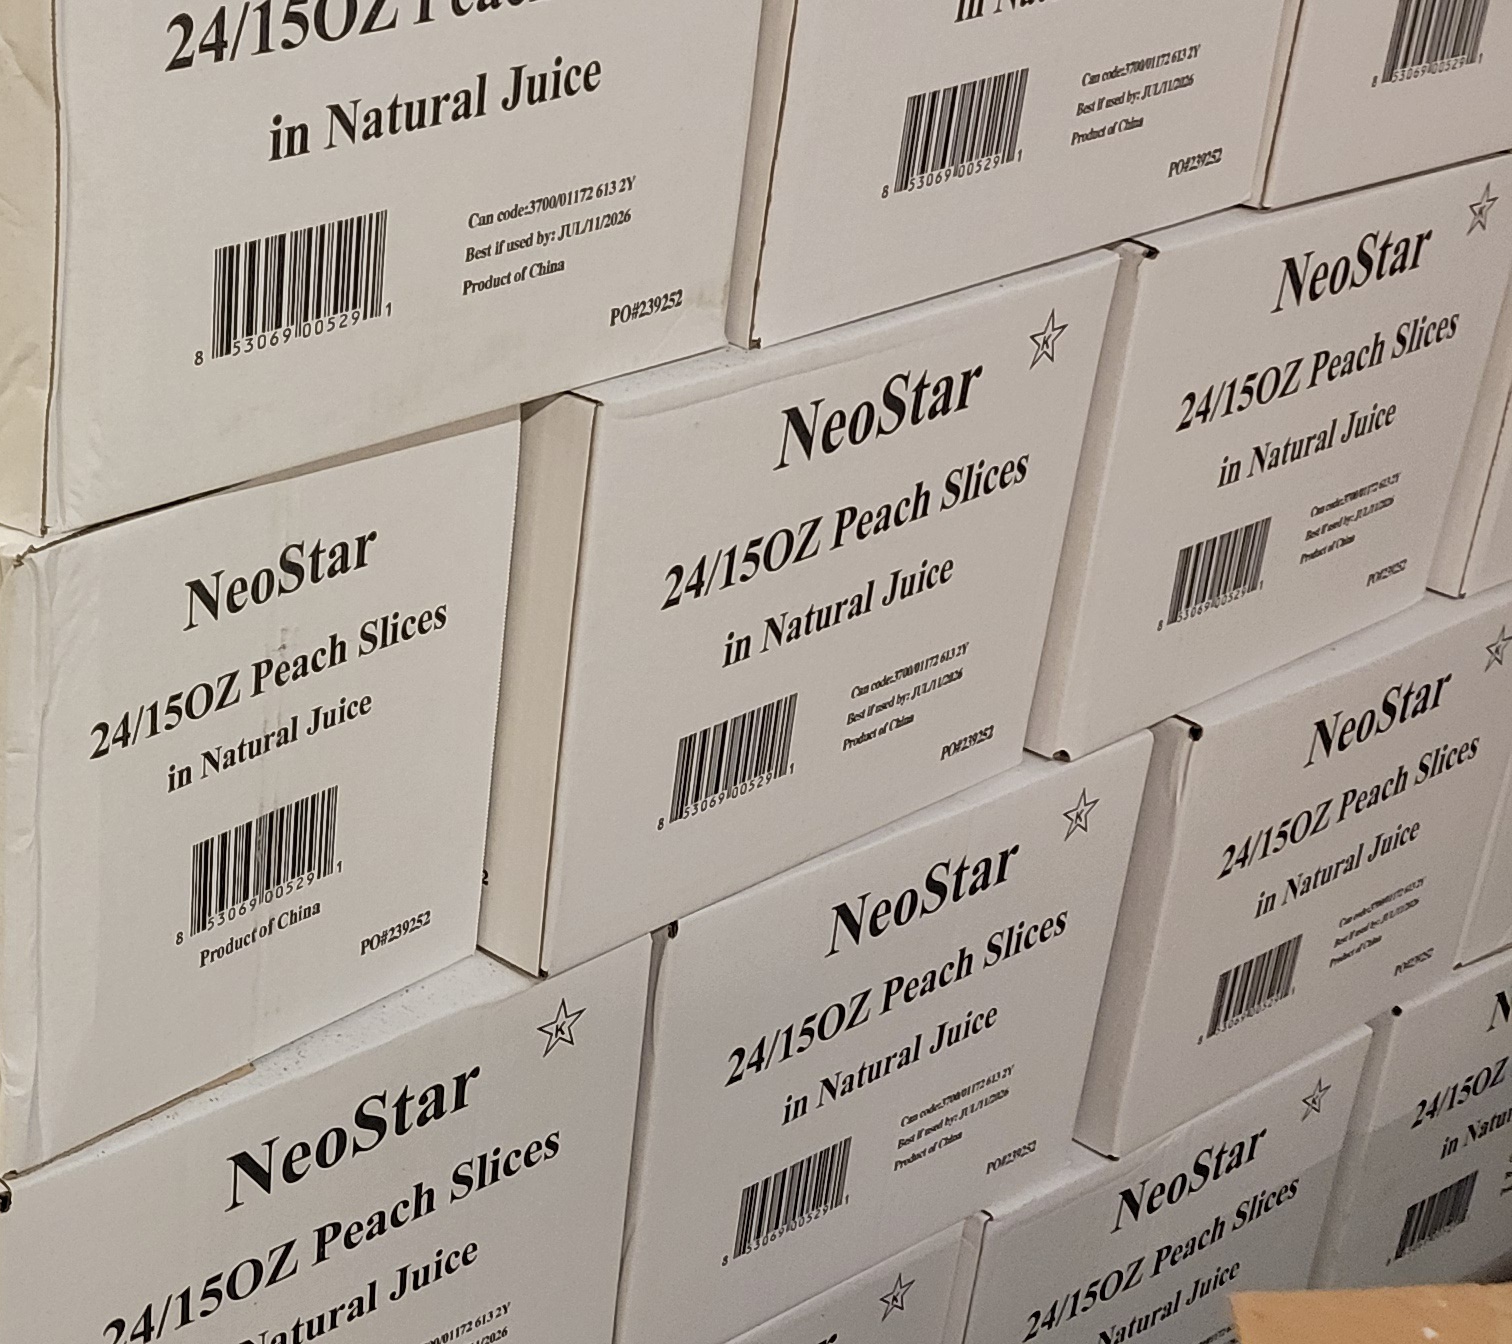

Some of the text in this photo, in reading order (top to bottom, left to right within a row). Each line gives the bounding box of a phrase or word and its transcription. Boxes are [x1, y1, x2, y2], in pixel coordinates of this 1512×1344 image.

[269, 56, 601, 161] in Natural Juice
[465, 209, 631, 262] Best if used by: JUL/11/2026
[468, 213, 494, 229] Can
[596, 180, 616, 198] 613
[619, 175, 636, 193] 2Y
[463, 260, 564, 295] Product of China
[610, 289, 683, 326] PO#239252
[183, 531, 377, 631] NeoStar
[90, 605, 446, 759] 24/15OZ Peach Slices
[225, 1066, 480, 1212] NeoStar
[312, 1182, 436, 1266] Peach
[450, 1131, 559, 1204] Slices
[389, 1243, 477, 1301] Juice
